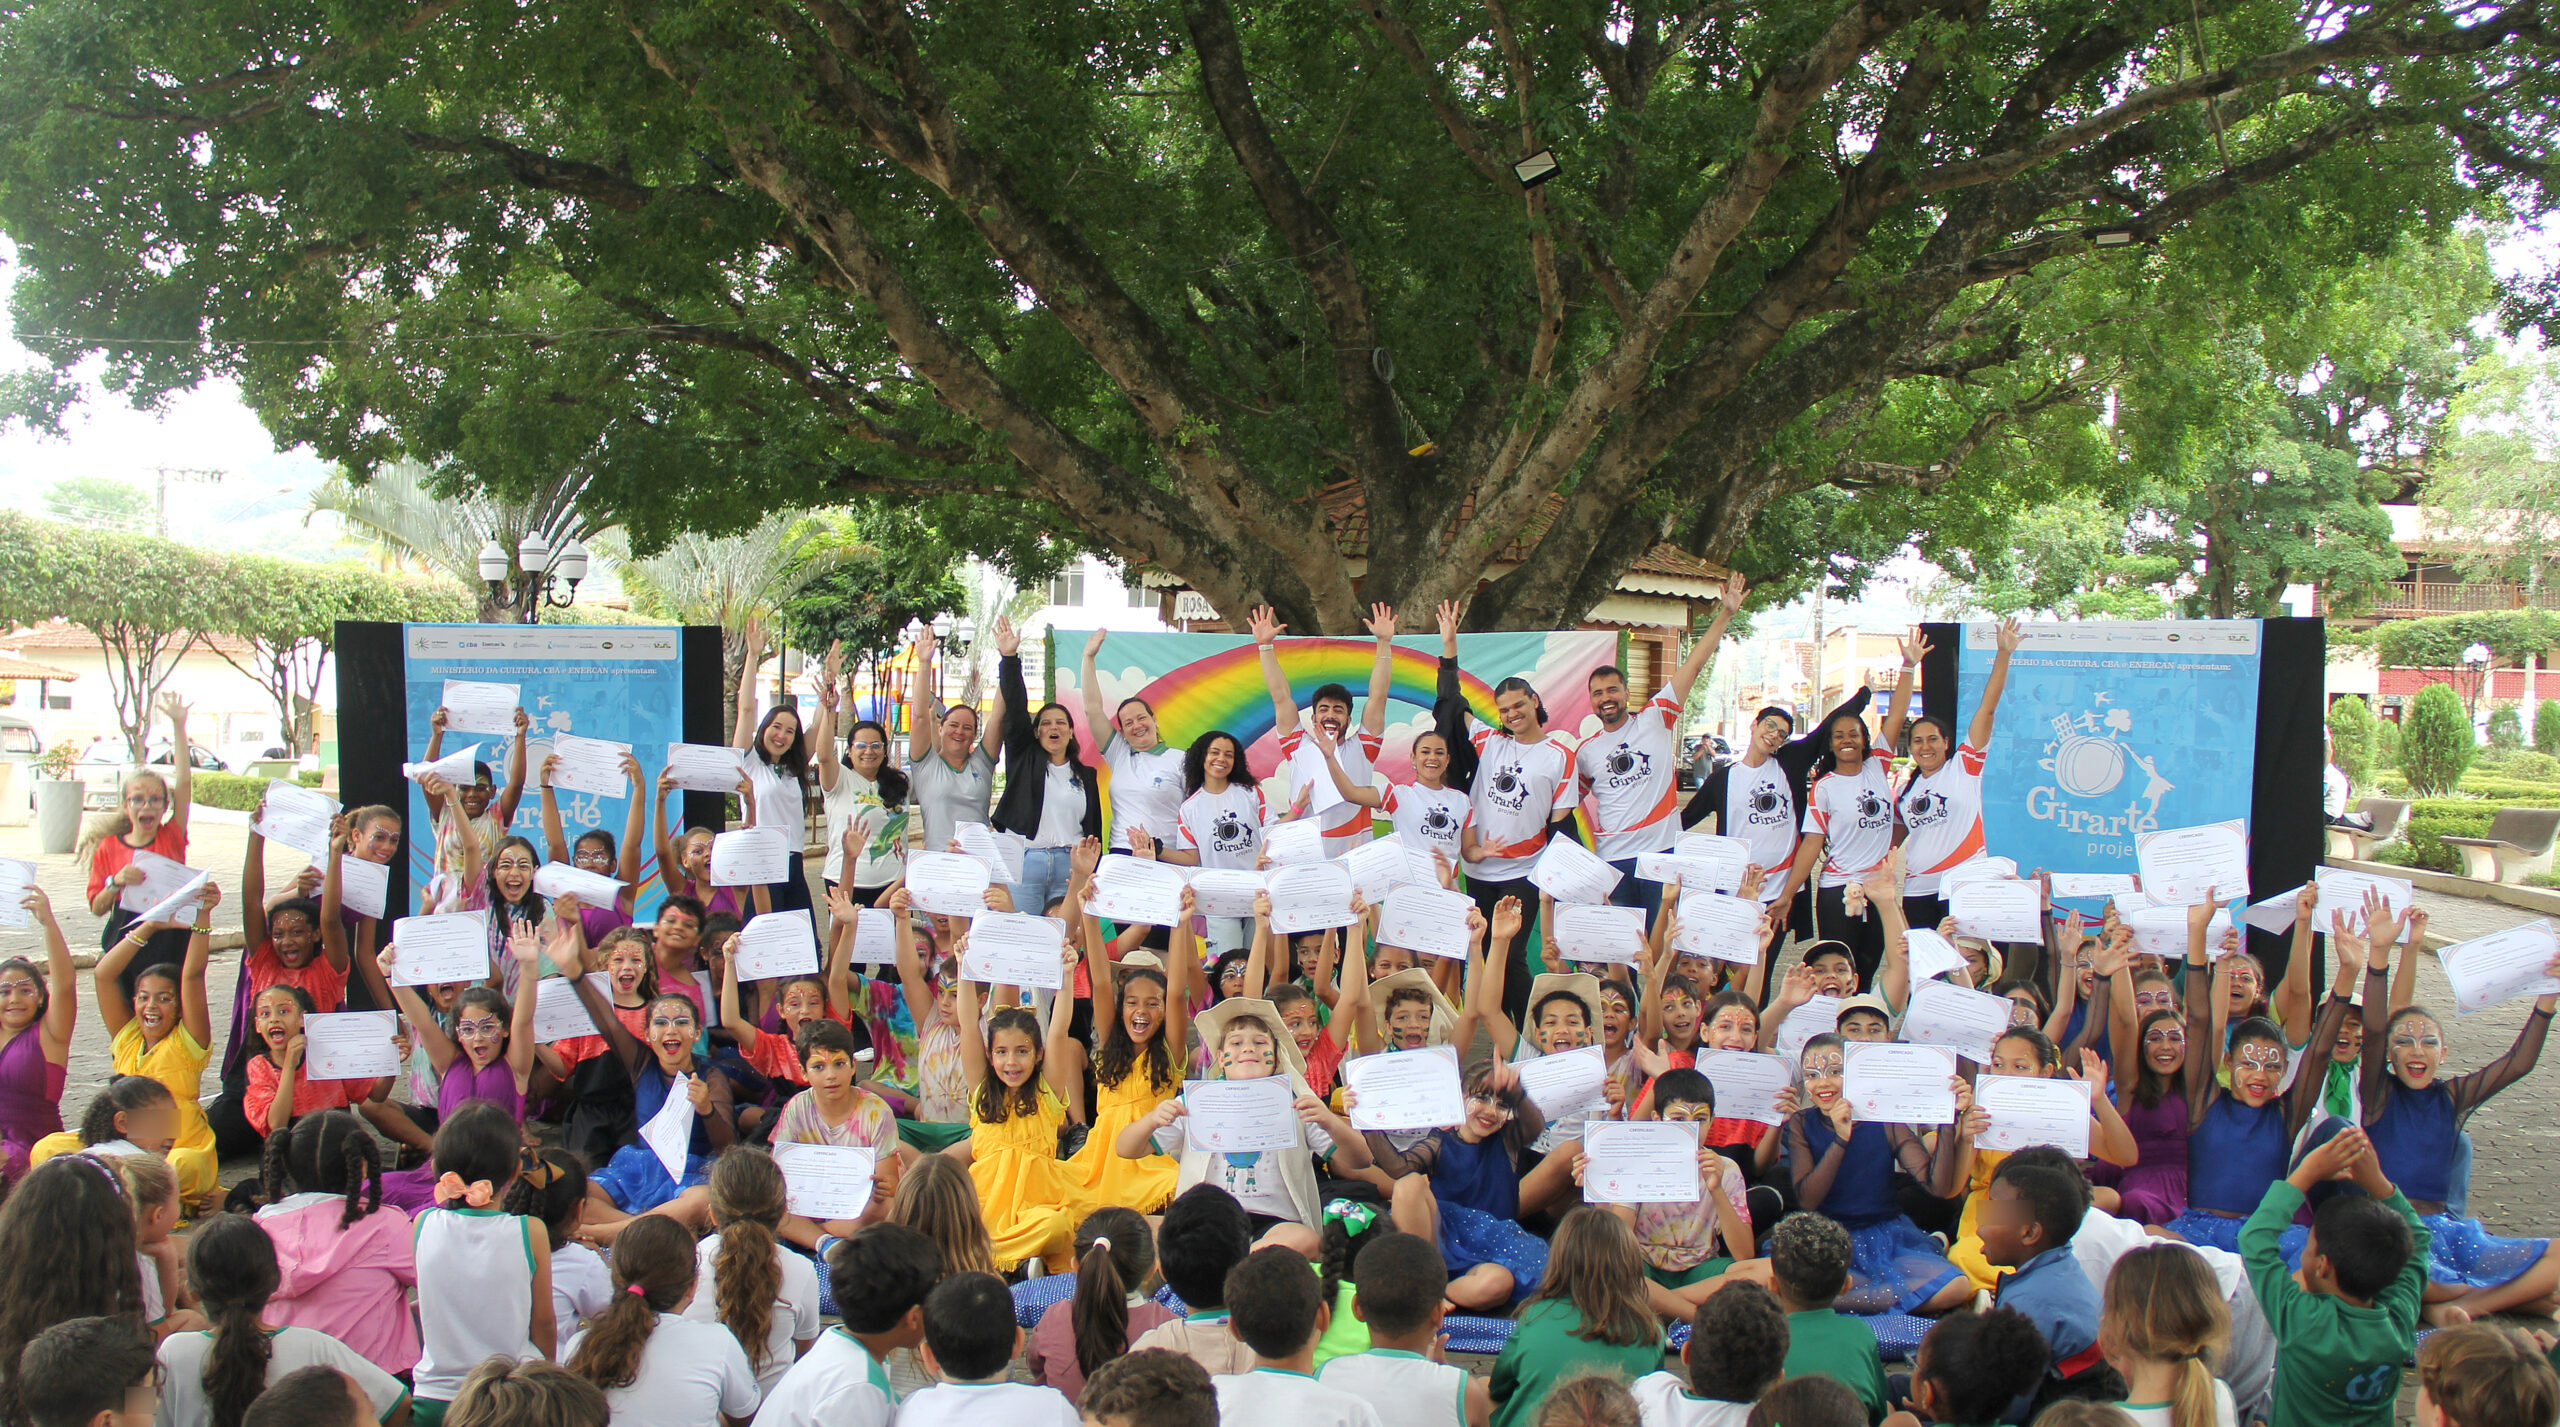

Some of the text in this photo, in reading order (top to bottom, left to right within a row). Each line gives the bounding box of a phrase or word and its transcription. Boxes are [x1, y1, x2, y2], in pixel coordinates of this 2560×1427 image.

[1182, 597, 1209, 613] ROSA
[487, 666, 498, 674] DA
[2041, 659, 2054, 667] DA
[2129, 661, 2175, 669] ENERCAN
[2087, 842, 2135, 859] proje
